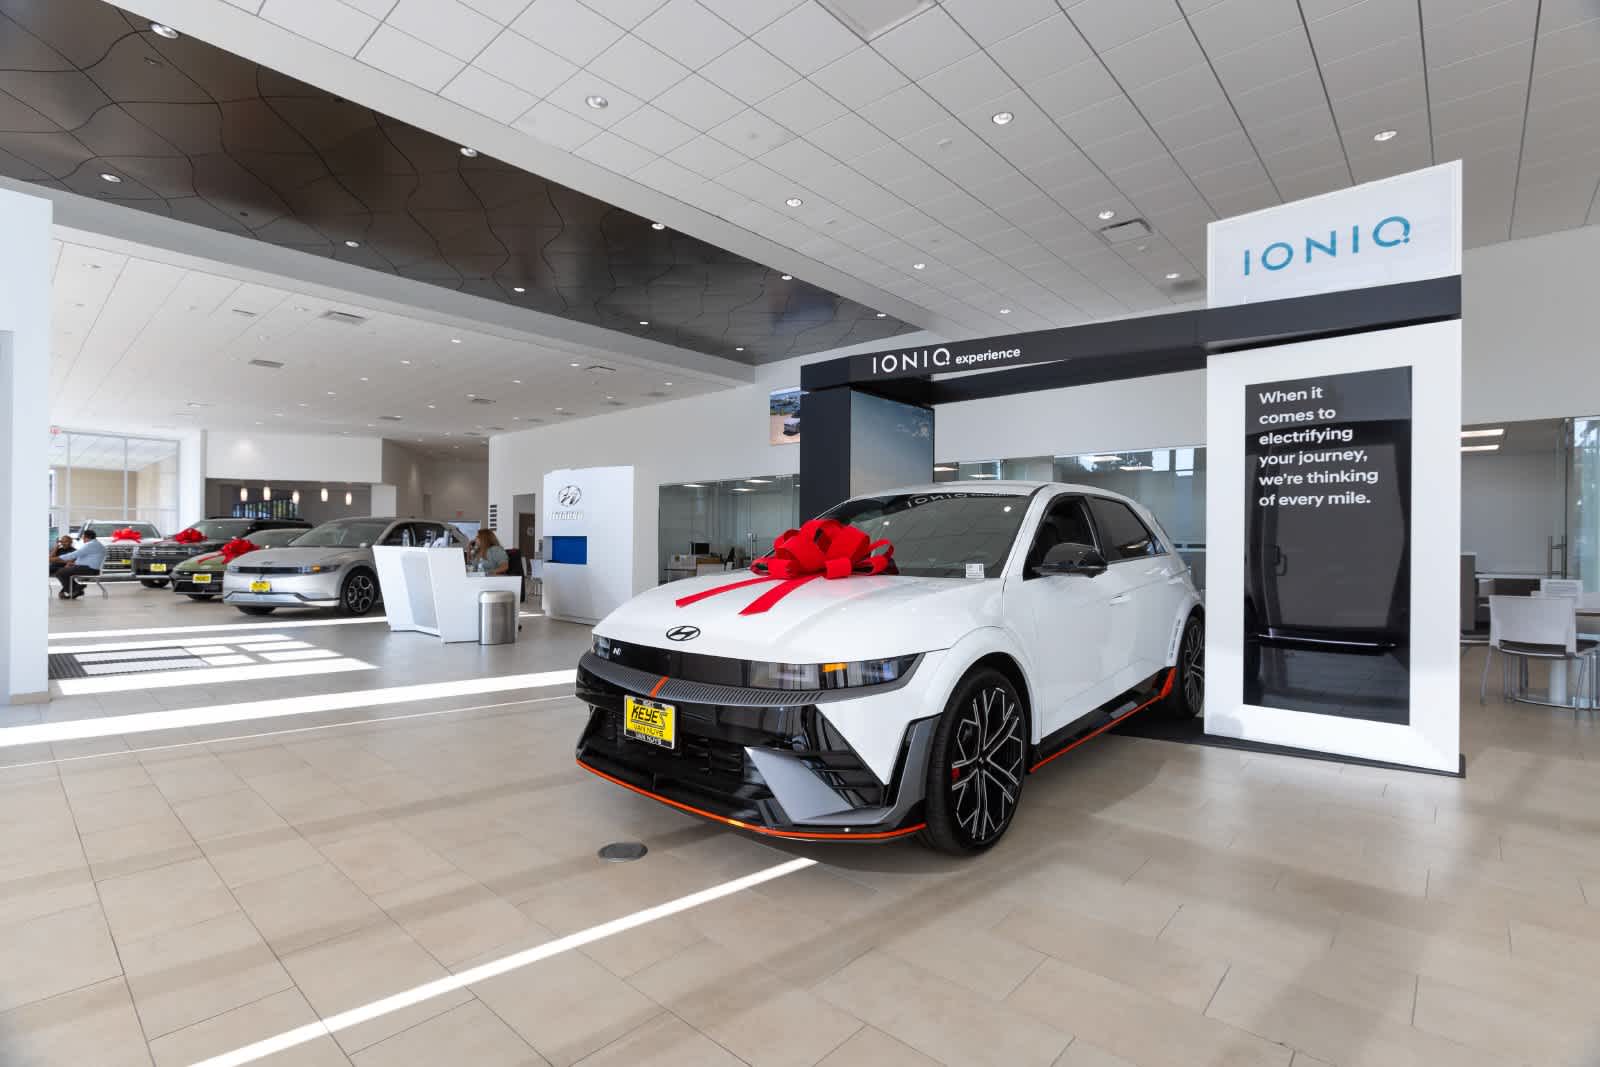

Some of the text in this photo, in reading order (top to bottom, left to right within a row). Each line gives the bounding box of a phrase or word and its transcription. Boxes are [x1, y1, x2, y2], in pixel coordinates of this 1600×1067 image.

[1244, 216, 1410, 276] IONIQ
[872, 348, 1021, 374] IONIQ experience
[1258, 386, 1324, 404] When it
[1258, 408, 1336, 424] comes to
[1258, 428, 1353, 445] electrifying
[1258, 450, 1368, 468] your journey,
[1258, 469, 1379, 486] we're thinking
[1258, 491, 1372, 507] of every mile.
[631, 704, 667, 730] KEYES
